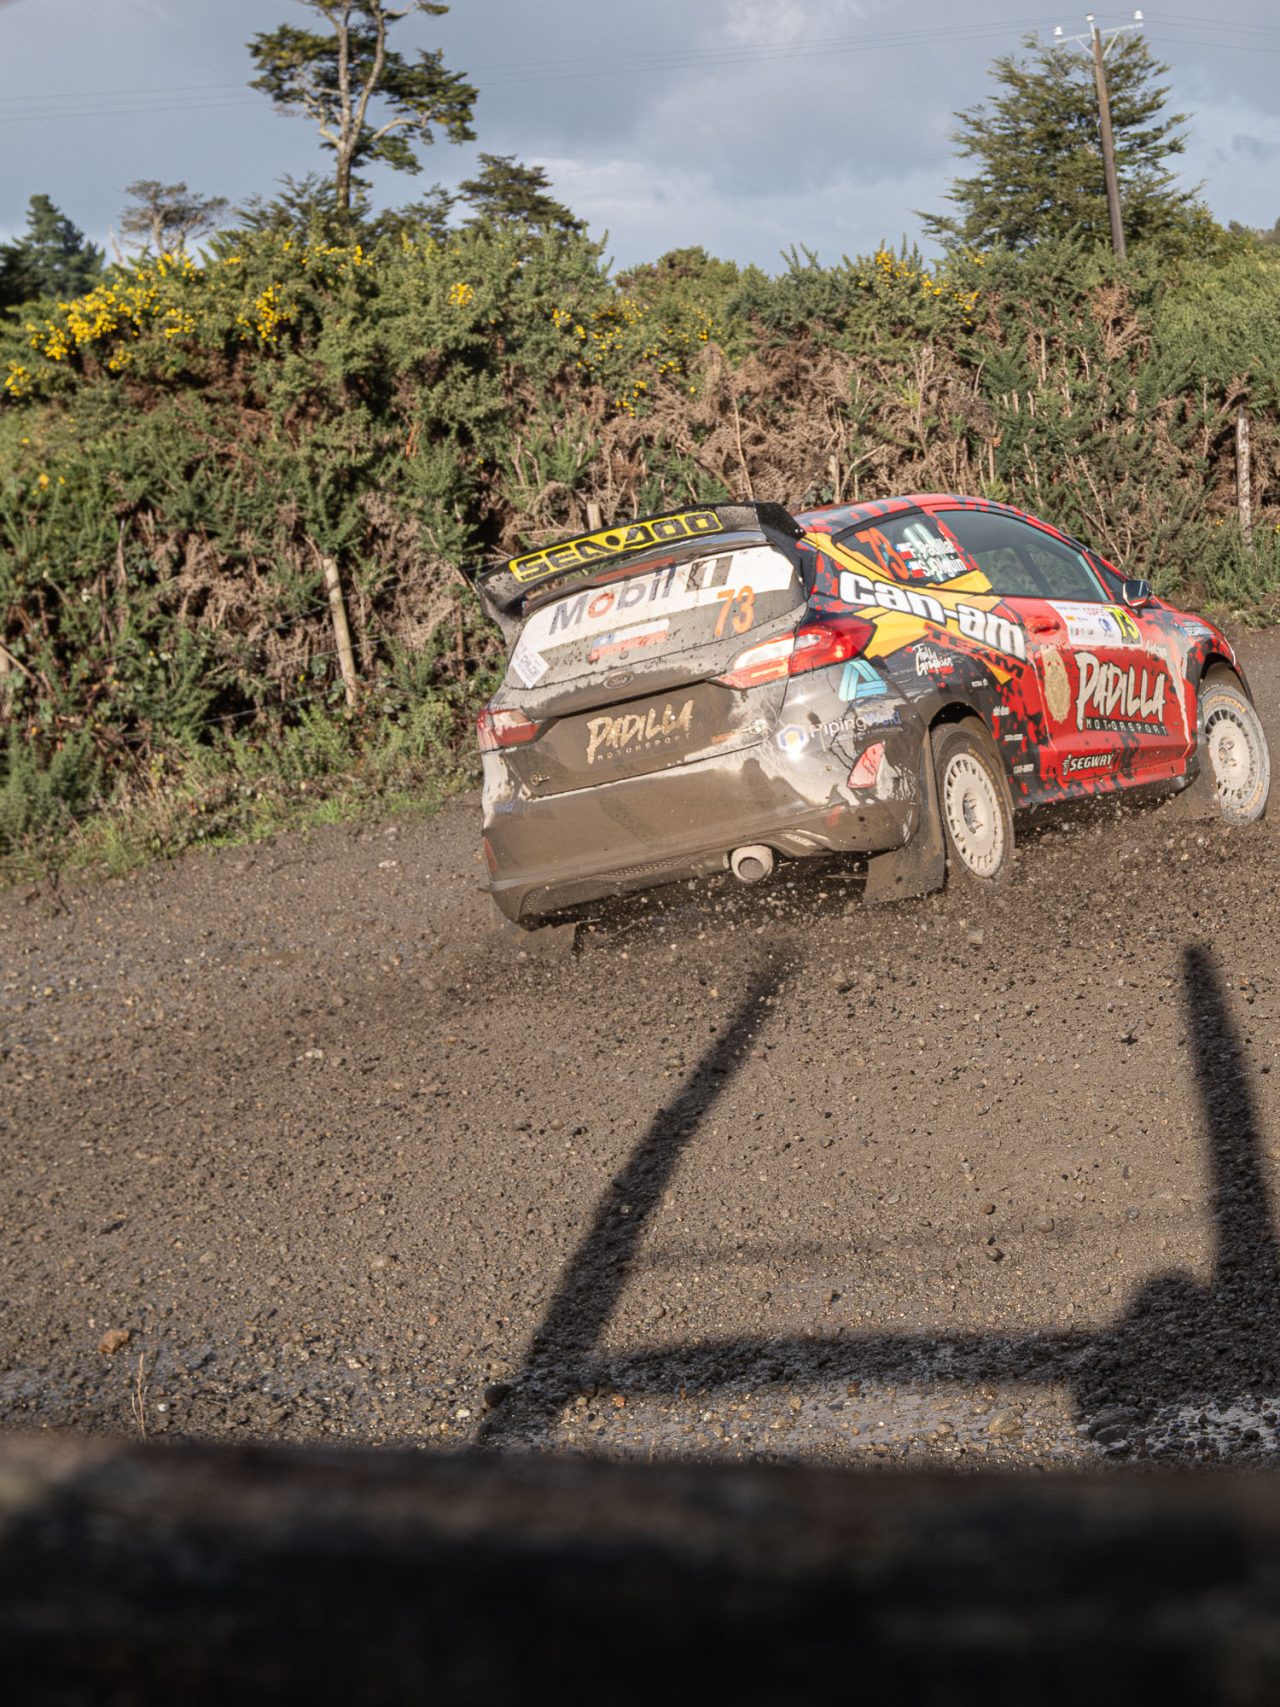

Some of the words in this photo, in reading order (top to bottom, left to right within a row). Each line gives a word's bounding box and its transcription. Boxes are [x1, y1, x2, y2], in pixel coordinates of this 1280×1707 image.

[854, 527, 910, 581] 73
[549, 563, 677, 635] Mobil
[715, 586, 754, 637] 73
[1104, 606, 1140, 640] 73
[926, 625, 1024, 678] TEAM
[1074, 651, 1166, 731] PADILLA
[586, 699, 694, 764] PADILLA
[1086, 719, 1167, 735] MOTORSPORT
[1070, 754, 1114, 771] SEGWAY
